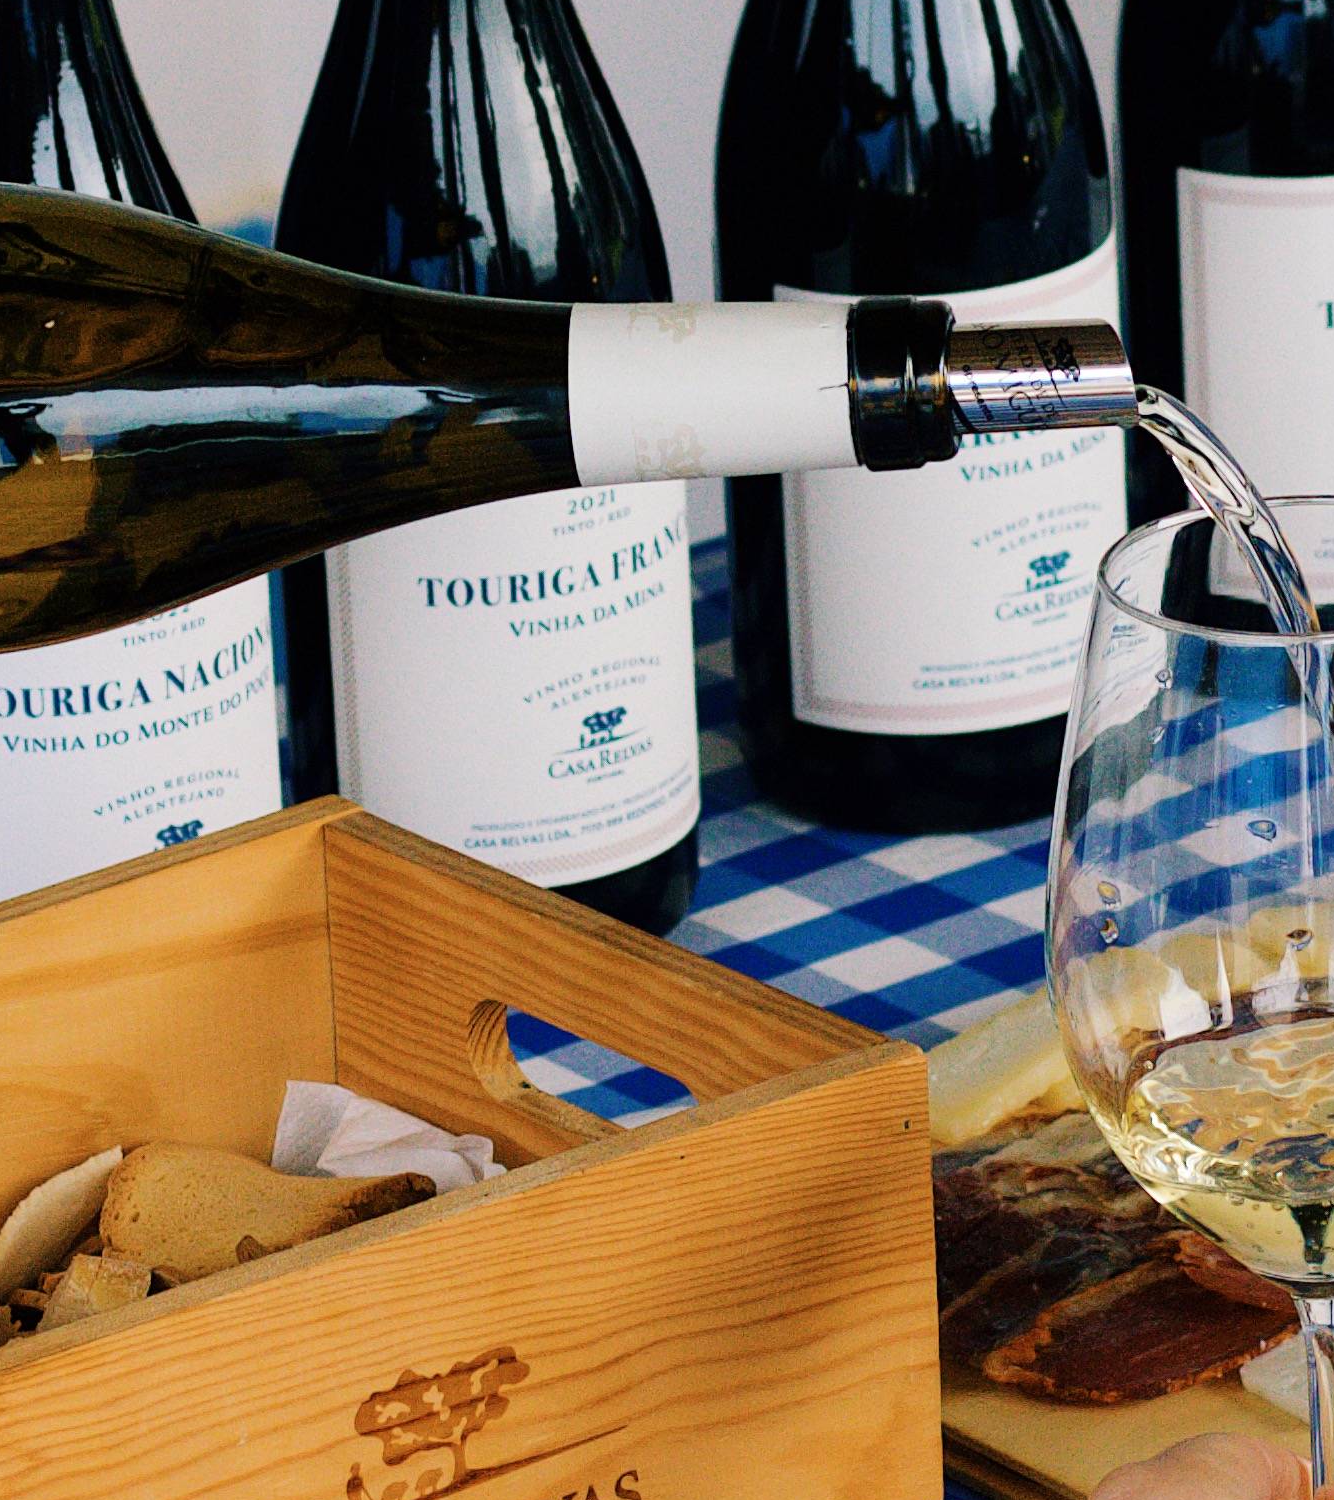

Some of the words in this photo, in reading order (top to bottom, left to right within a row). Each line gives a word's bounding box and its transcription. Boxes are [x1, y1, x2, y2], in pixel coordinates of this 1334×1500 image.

[958, 457, 1034, 483] VINHA
[1041, 450, 1066, 469] DA
[567, 488, 618, 516] 2021
[417, 560, 603, 608] TOURIGA
[121, 629, 168, 649] TINTO
[179, 616, 207, 635] RED
[509, 612, 587, 638] VINHA
[593, 602, 618, 623] DA
[521, 672, 584, 705] VINHO
[2, 734, 87, 754] VINHA
[94, 728, 130, 749] DO
[137, 704, 215, 743] MONTE
[219, 692, 242, 716] DO
[548, 757, 597, 779] CASA
[599, 735, 654, 769] RELVAS
[93, 784, 157, 818] VINHO
[162, 766, 241, 790] REGIONAL
[122, 785, 226, 825] ALENTEJANO
[463, 837, 497, 850] CASA
